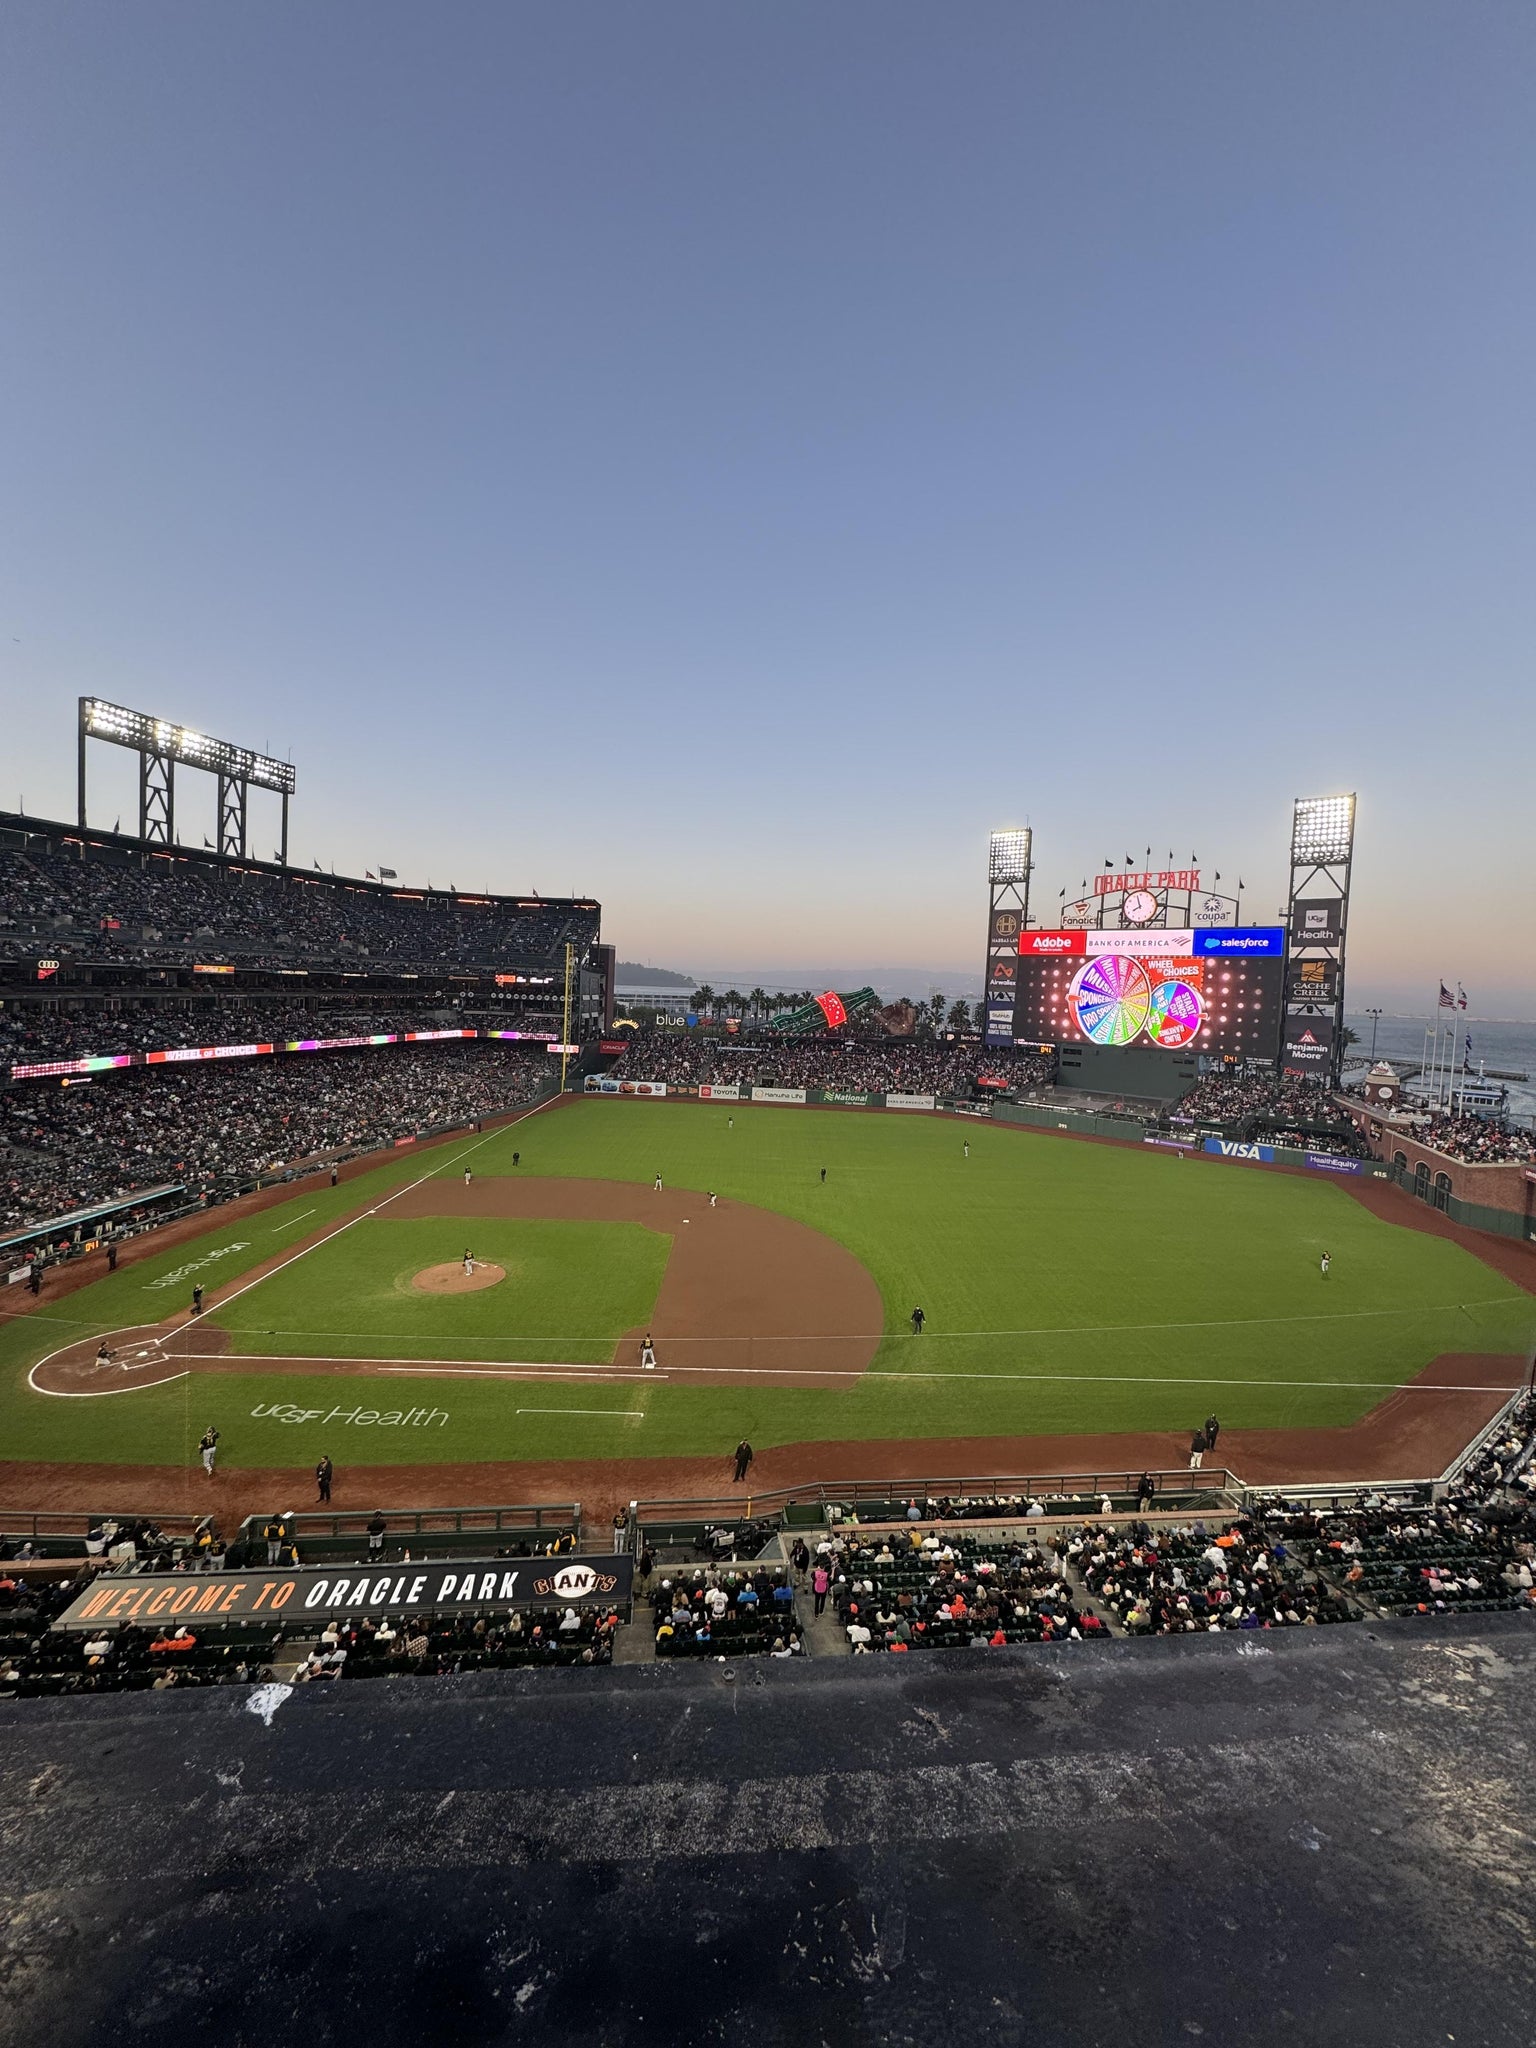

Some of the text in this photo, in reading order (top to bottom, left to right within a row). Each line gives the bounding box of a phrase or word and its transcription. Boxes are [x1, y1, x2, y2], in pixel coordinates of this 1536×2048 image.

[1094, 870, 1200, 896] ORACLE PARK
[1197, 912, 1226, 922] coupa
[1307, 914, 1326, 923] UCSF
[1297, 930, 1334, 939] Health
[1032, 936, 1072, 948] Adobe
[1088, 939, 1169, 947] BANK OF AMERICA
[1221, 937, 1269, 949] salesforce
[1148, 960, 1174, 970] WHEEL
[1163, 966, 1199, 977] CHOICES
[1293, 982, 1331, 990] CACHE
[1293, 989, 1329, 997] CREEK
[1169, 1003, 1179, 1017] CUT
[1175, 995, 1189, 1019] BENCH
[1182, 992, 1197, 1016] START
[656, 1013, 685, 1027] blue
[1082, 1012, 1099, 1029] PRO
[166, 1045, 258, 1062] WHEEL OF CHOICES
[1286, 1042, 1328, 1053] Benjamin
[1291, 1051, 1322, 1060] Moore
[834, 1092, 868, 1102] National
[1257, 1137, 1288, 1146] WELCOME
[1218, 1140, 1260, 1160] VISA
[1310, 1155, 1358, 1170] HealthEquity
[1372, 1170, 1387, 1178] 415
[142, 1258, 220, 1289] Health
[250, 1403, 450, 1427] UCSF Health
[532, 1572, 617, 1595] GIANTS
[78, 1571, 519, 1618] WELCOME TO ORACLE PARK
